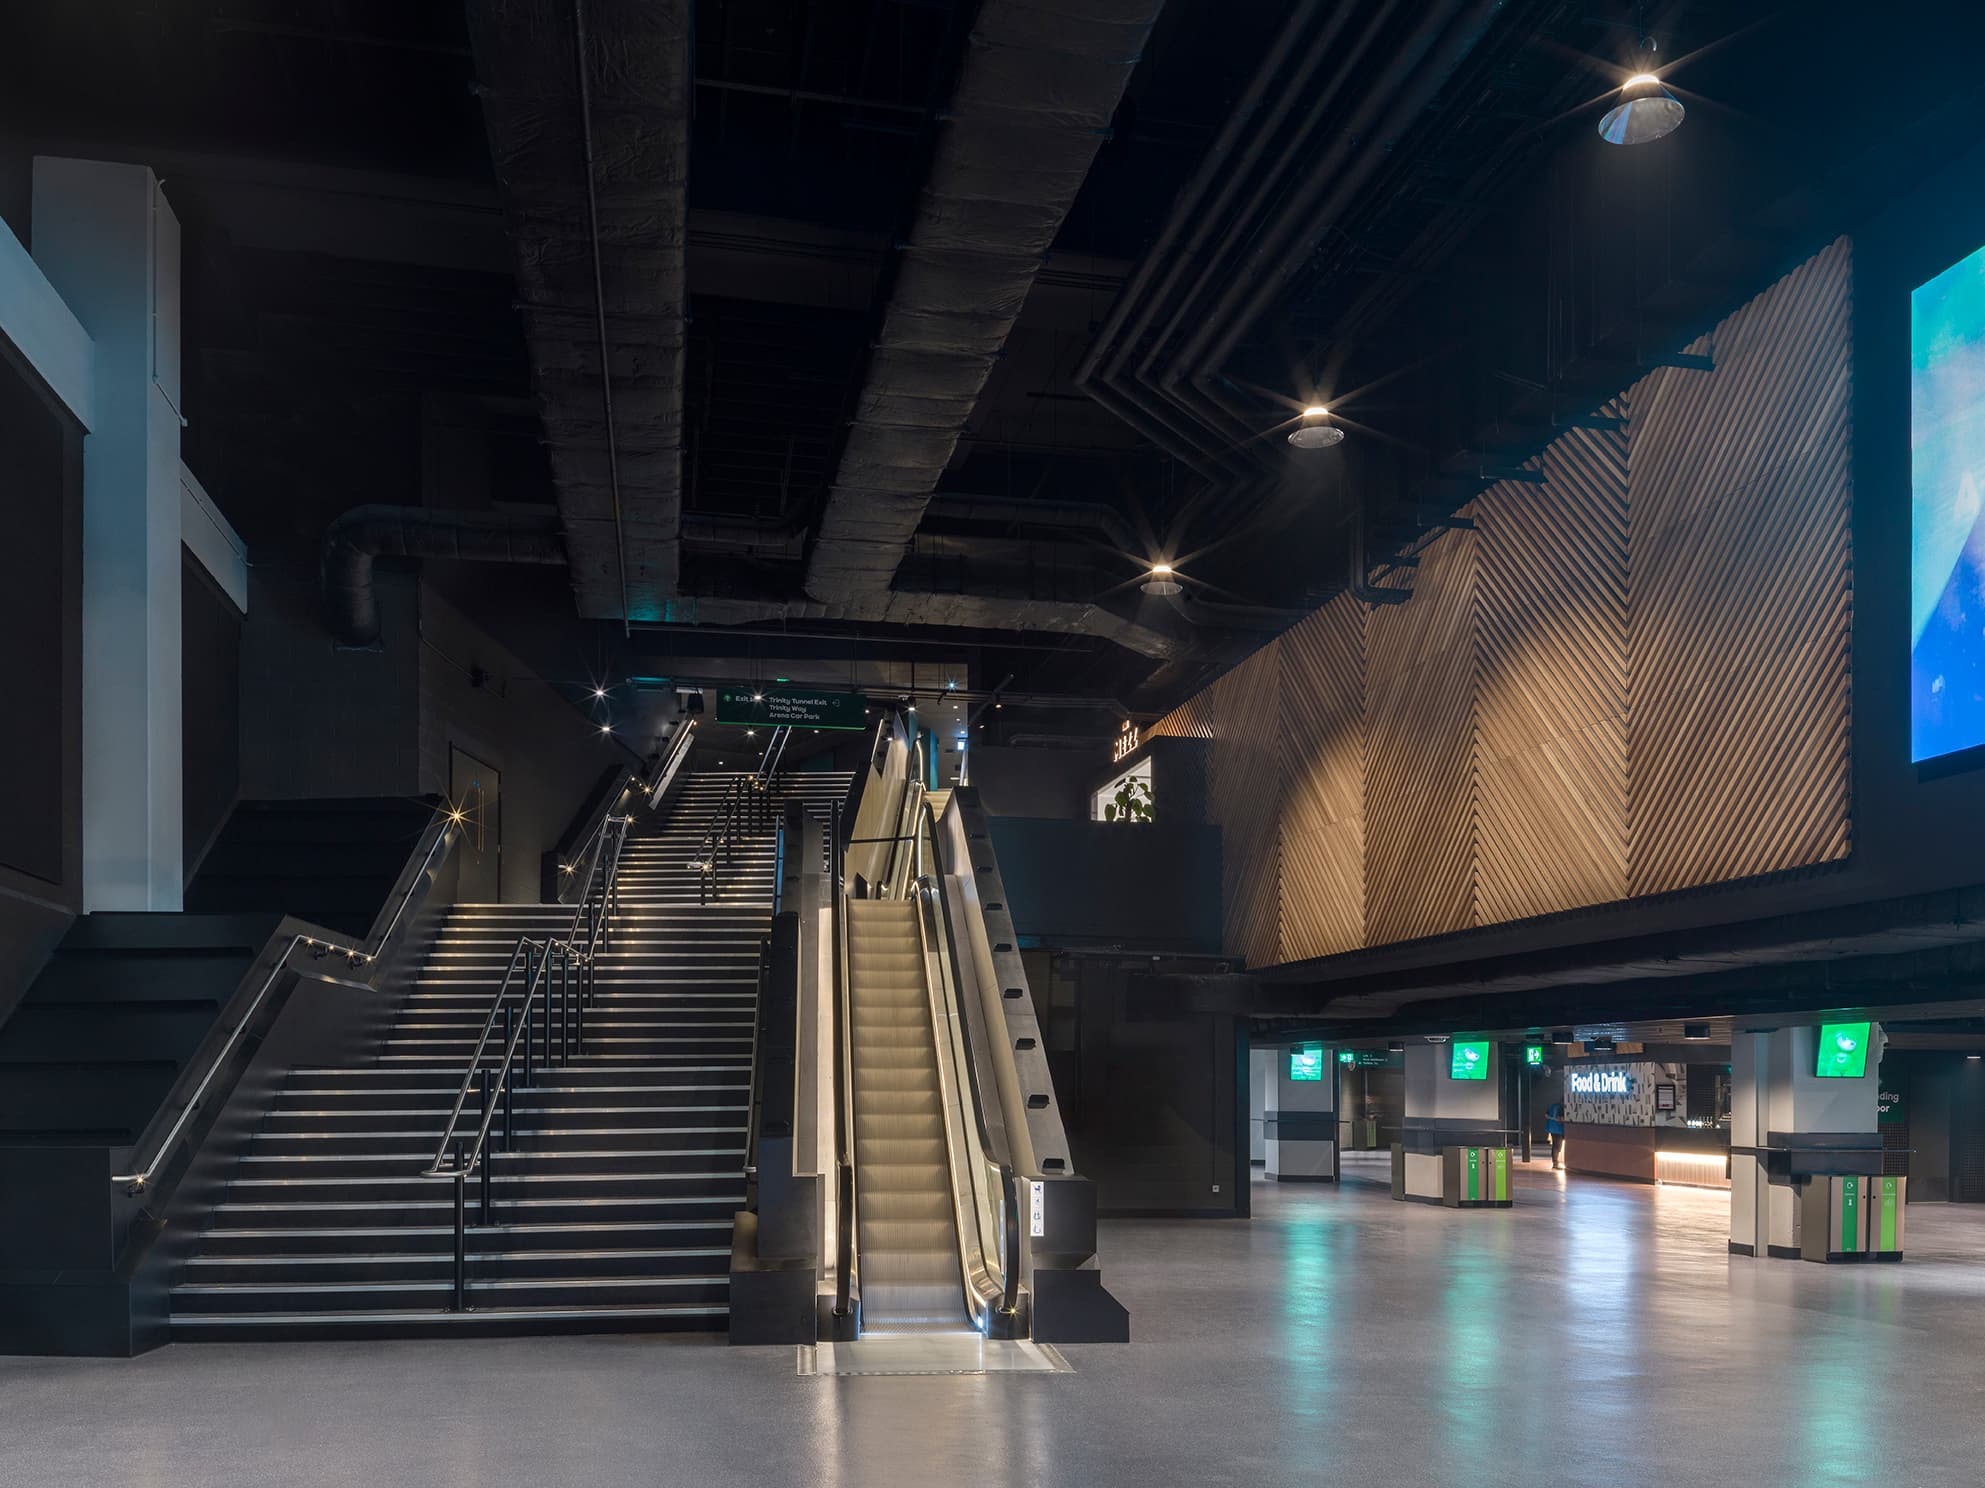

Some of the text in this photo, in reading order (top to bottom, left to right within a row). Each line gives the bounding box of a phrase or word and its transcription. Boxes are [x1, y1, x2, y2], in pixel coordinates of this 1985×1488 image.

[769, 696, 791, 705] Trinity
[769, 705, 807, 713] Trinity Way
[1571, 1071, 1627, 1092] Food & Drink
